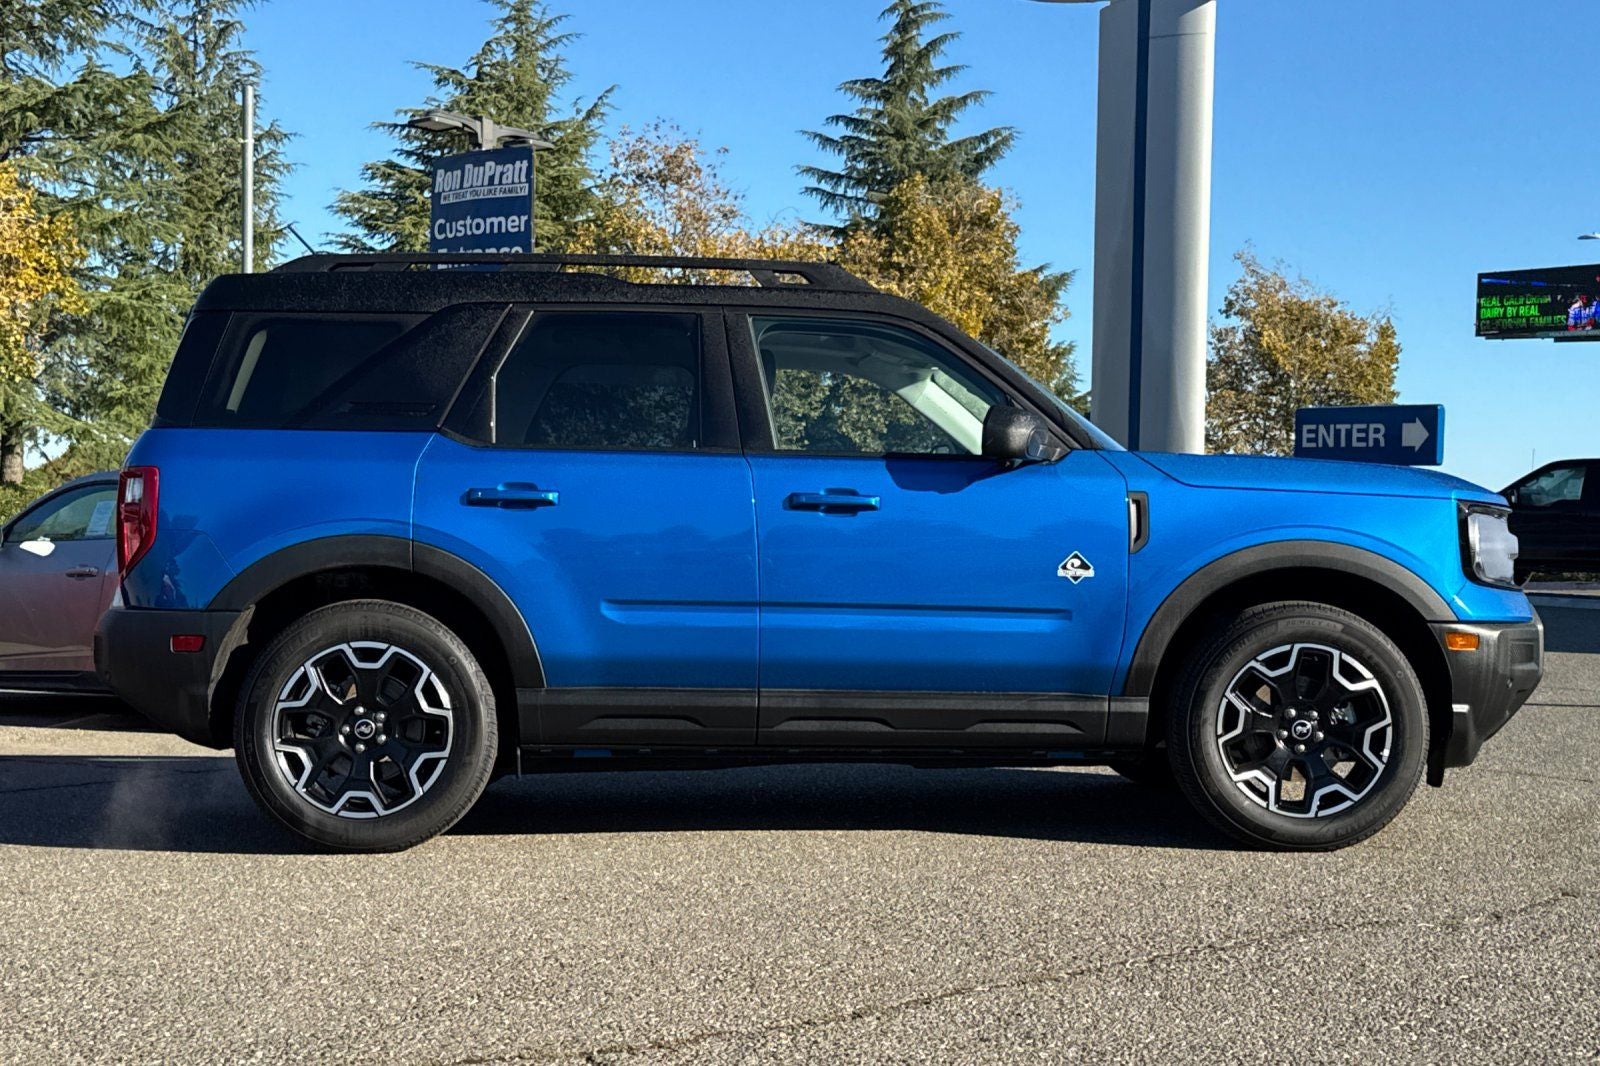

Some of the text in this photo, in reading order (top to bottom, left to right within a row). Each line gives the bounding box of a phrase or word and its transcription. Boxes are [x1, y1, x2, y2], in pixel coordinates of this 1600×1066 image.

[434, 160, 529, 193] Ron DuPratt
[442, 185, 527, 202] WE TREAT YOU LIKE FAMILY!
[434, 215, 529, 240] Customer
[1480, 305, 1540, 319] DAIRY BY REAL
[1302, 423, 1386, 448] ENTER
